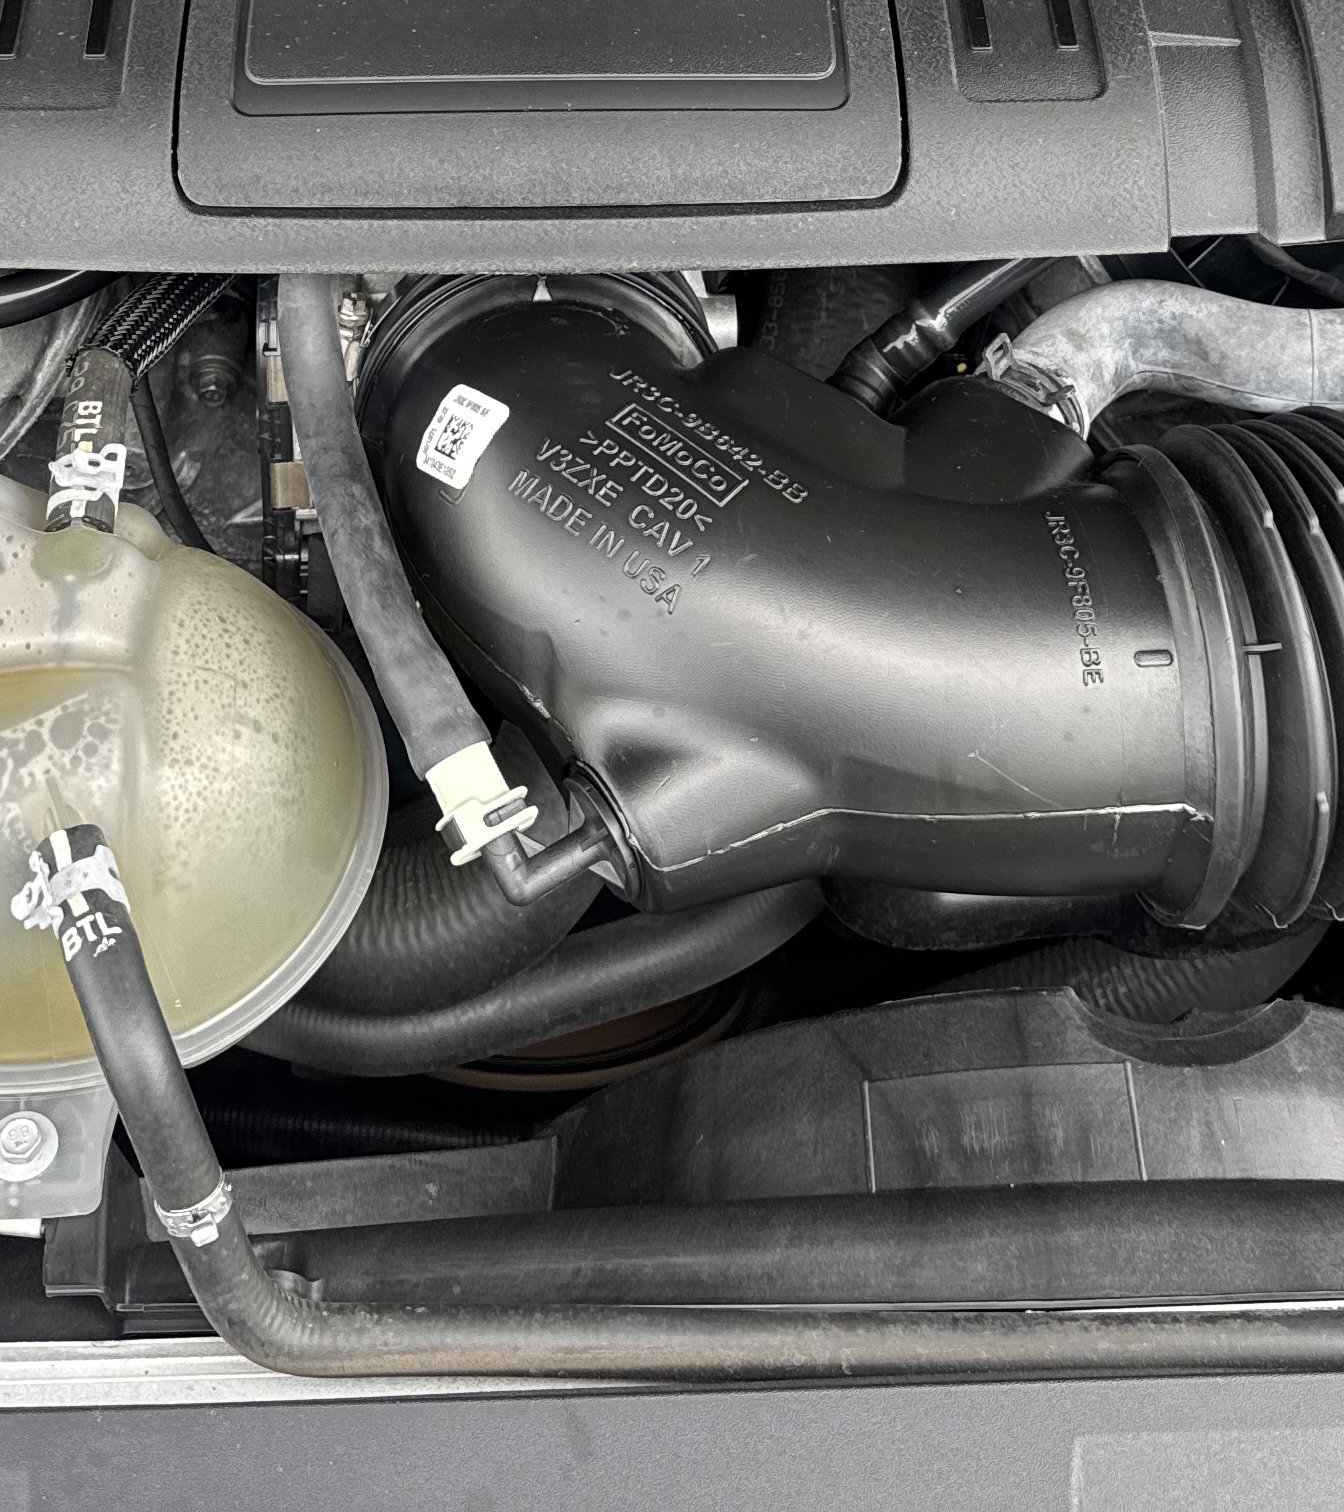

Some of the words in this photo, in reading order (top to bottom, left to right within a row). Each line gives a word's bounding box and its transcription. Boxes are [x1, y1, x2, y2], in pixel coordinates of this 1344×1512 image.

[74, 400, 103, 443] BTL
[508, 469, 593, 536] MADE
[588, 523, 625, 559] IN
[622, 549, 683, 615] USA
[536, 438, 624, 507] V3ZXE
[627, 504, 694, 557] CAV
[690, 553, 711, 577] 1
[61, 911, 123, 962] BTL
